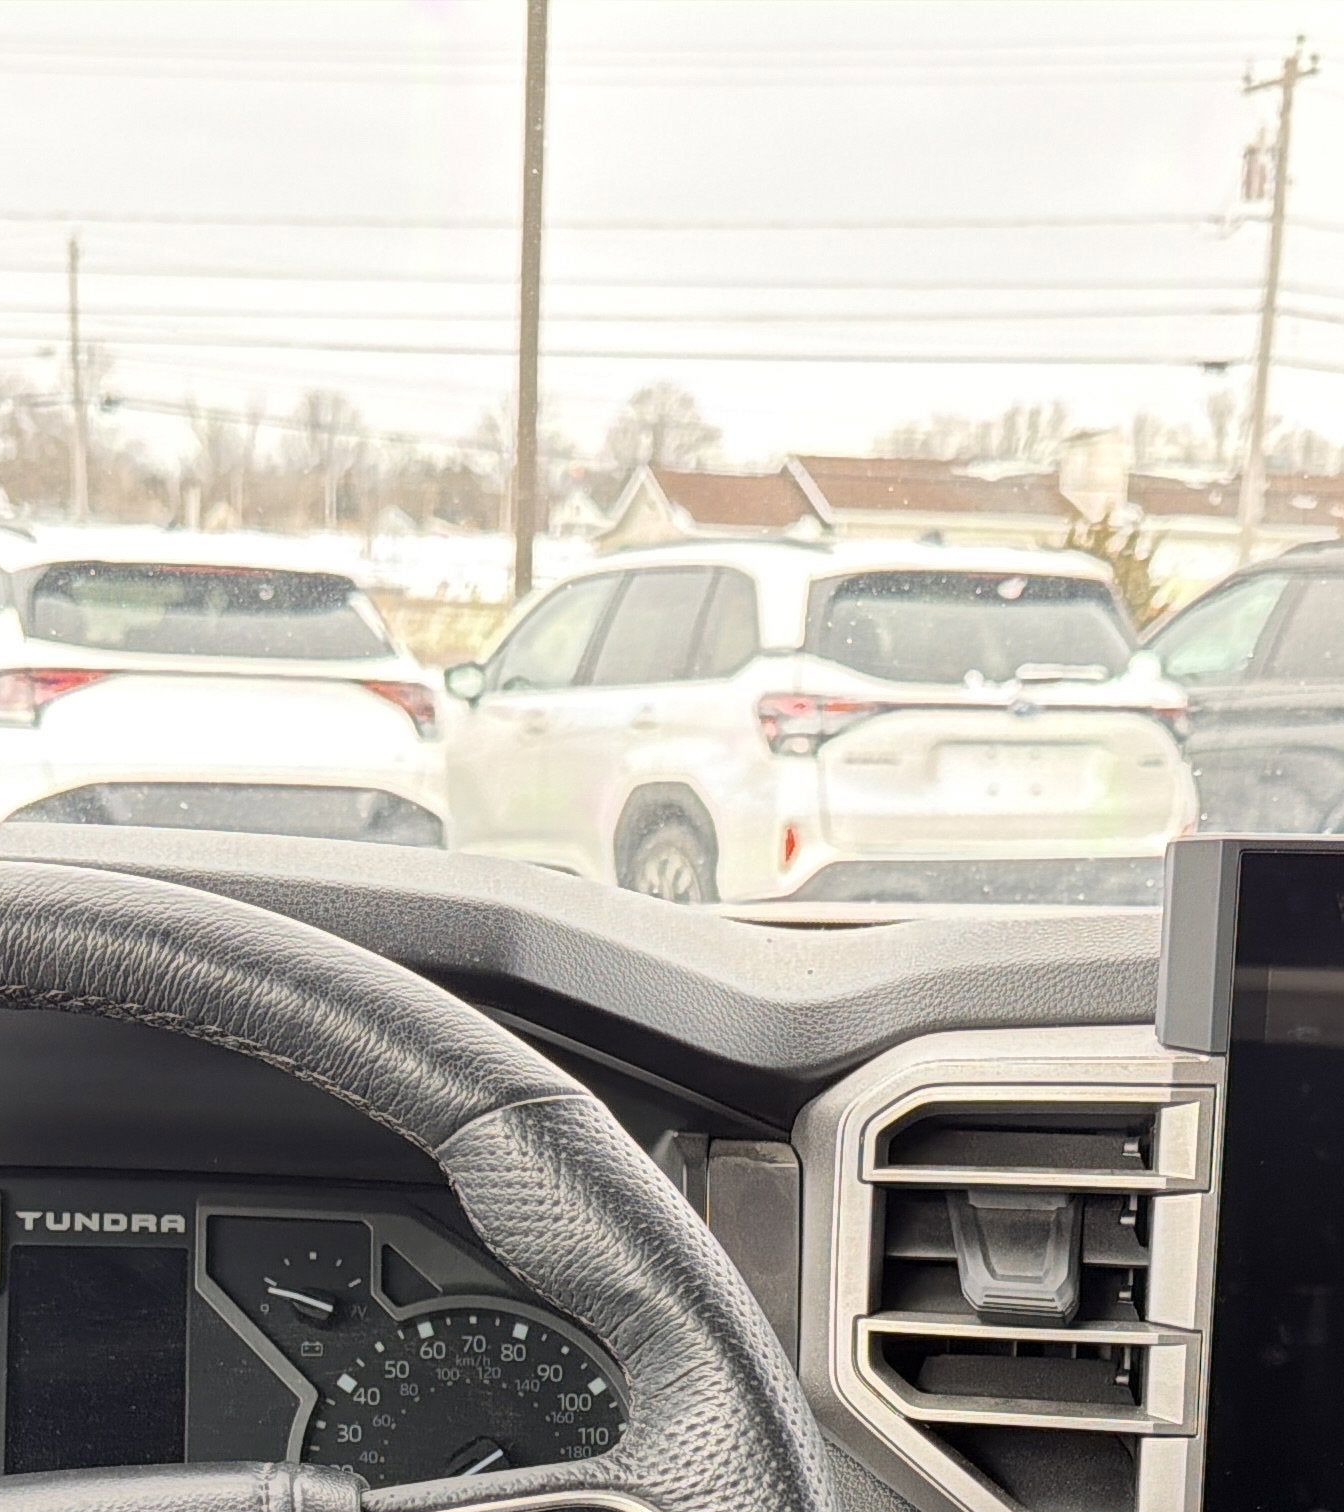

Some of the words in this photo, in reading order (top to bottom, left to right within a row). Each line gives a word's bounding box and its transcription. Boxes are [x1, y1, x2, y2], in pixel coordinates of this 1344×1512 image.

[15, 1211, 186, 1233] TUNDRA
[419, 1341, 446, 1359] 60
[461, 1335, 487, 1353] 70
[500, 1344, 527, 1362] 80
[384, 1360, 410, 1379] 50
[456, 1354, 491, 1367] km/h
[436, 1368, 460, 1381] 100
[478, 1367, 502, 1380] 120
[537, 1364, 563, 1383] 90
[400, 1383, 419, 1396] 80
[515, 1379, 540, 1393] 140
[353, 1387, 381, 1406] 40
[557, 1393, 592, 1412] 100
[372, 1414, 391, 1427] 60
[551, 1412, 575, 1424] 160
[337, 1424, 362, 1443] 30
[577, 1427, 609, 1446] 110
[359, 1451, 379, 1464] 40
[567, 1446, 592, 1459] 180
